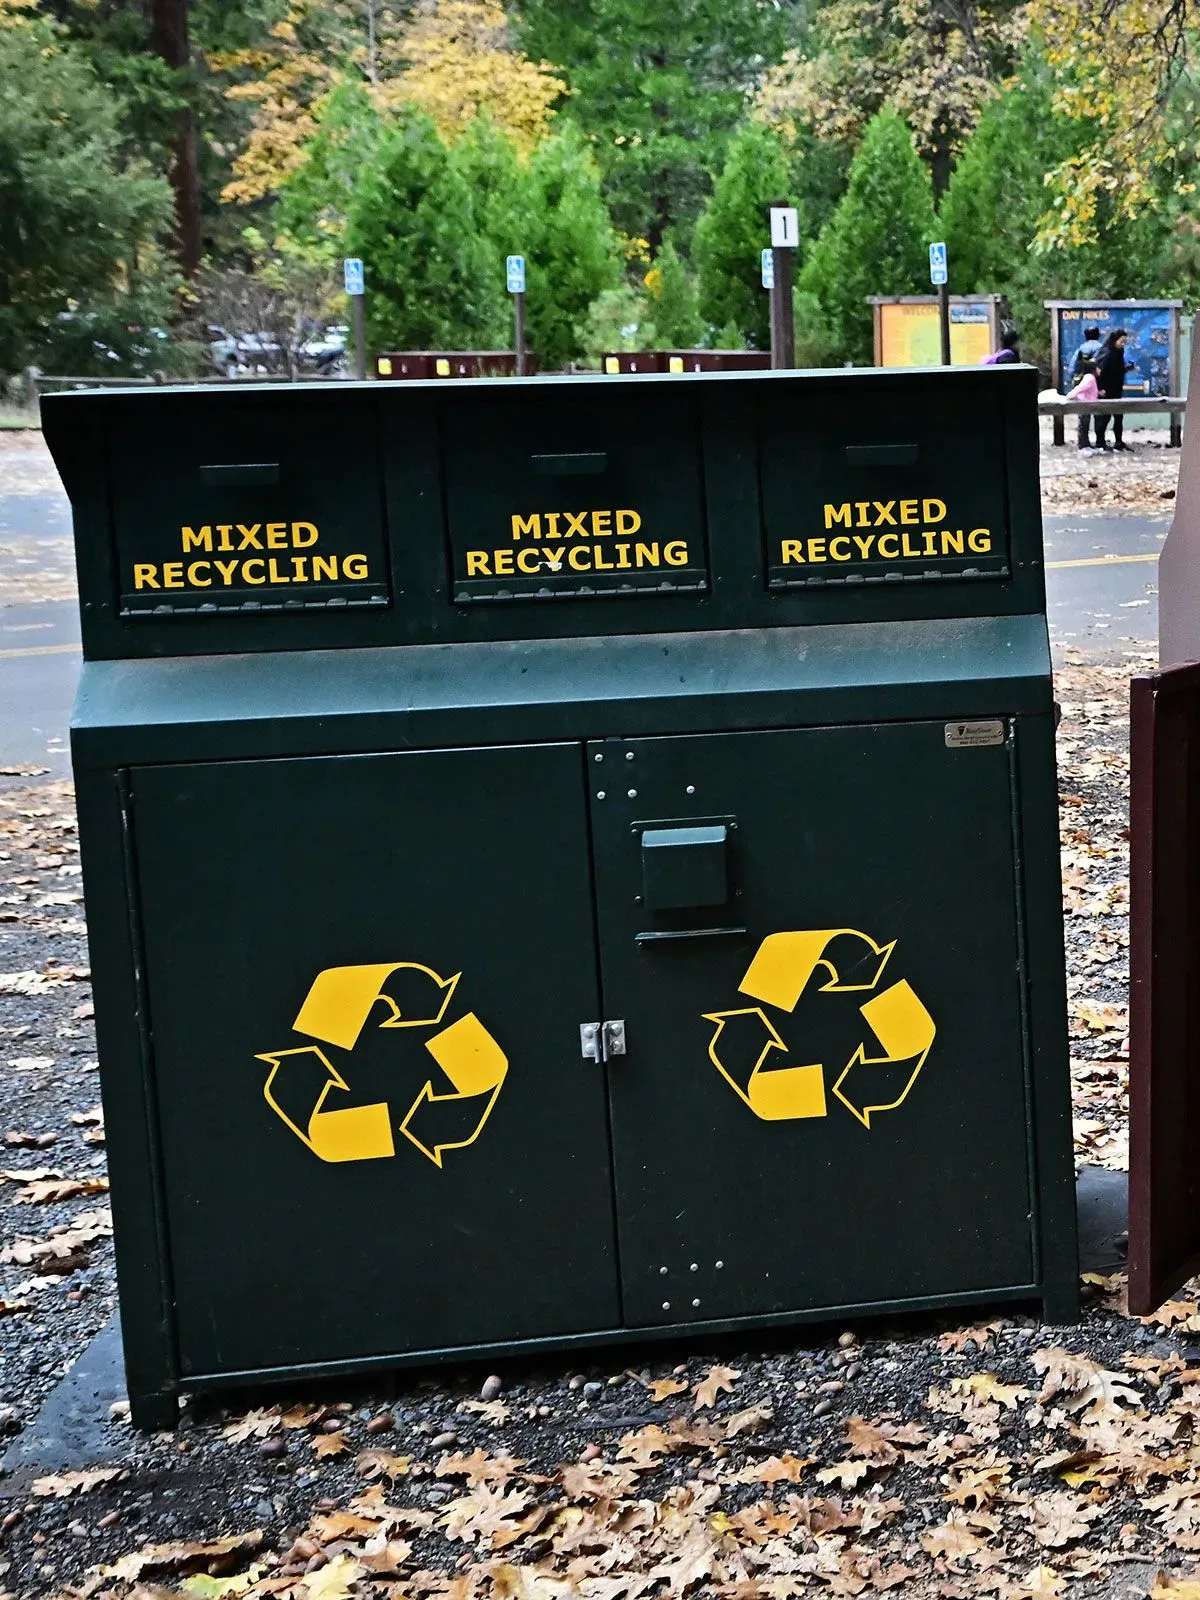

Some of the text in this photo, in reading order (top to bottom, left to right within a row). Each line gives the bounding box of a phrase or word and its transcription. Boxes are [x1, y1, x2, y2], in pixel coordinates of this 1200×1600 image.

[782, 216, 788, 239] 1
[511, 509, 642, 541] MIXED
[823, 498, 948, 528] MIXED
[181, 522, 320, 553] MIXED
[780, 527, 993, 564] RECYCLING
[133, 552, 370, 590] RECYCLING
[466, 540, 690, 577] RECYCLING
